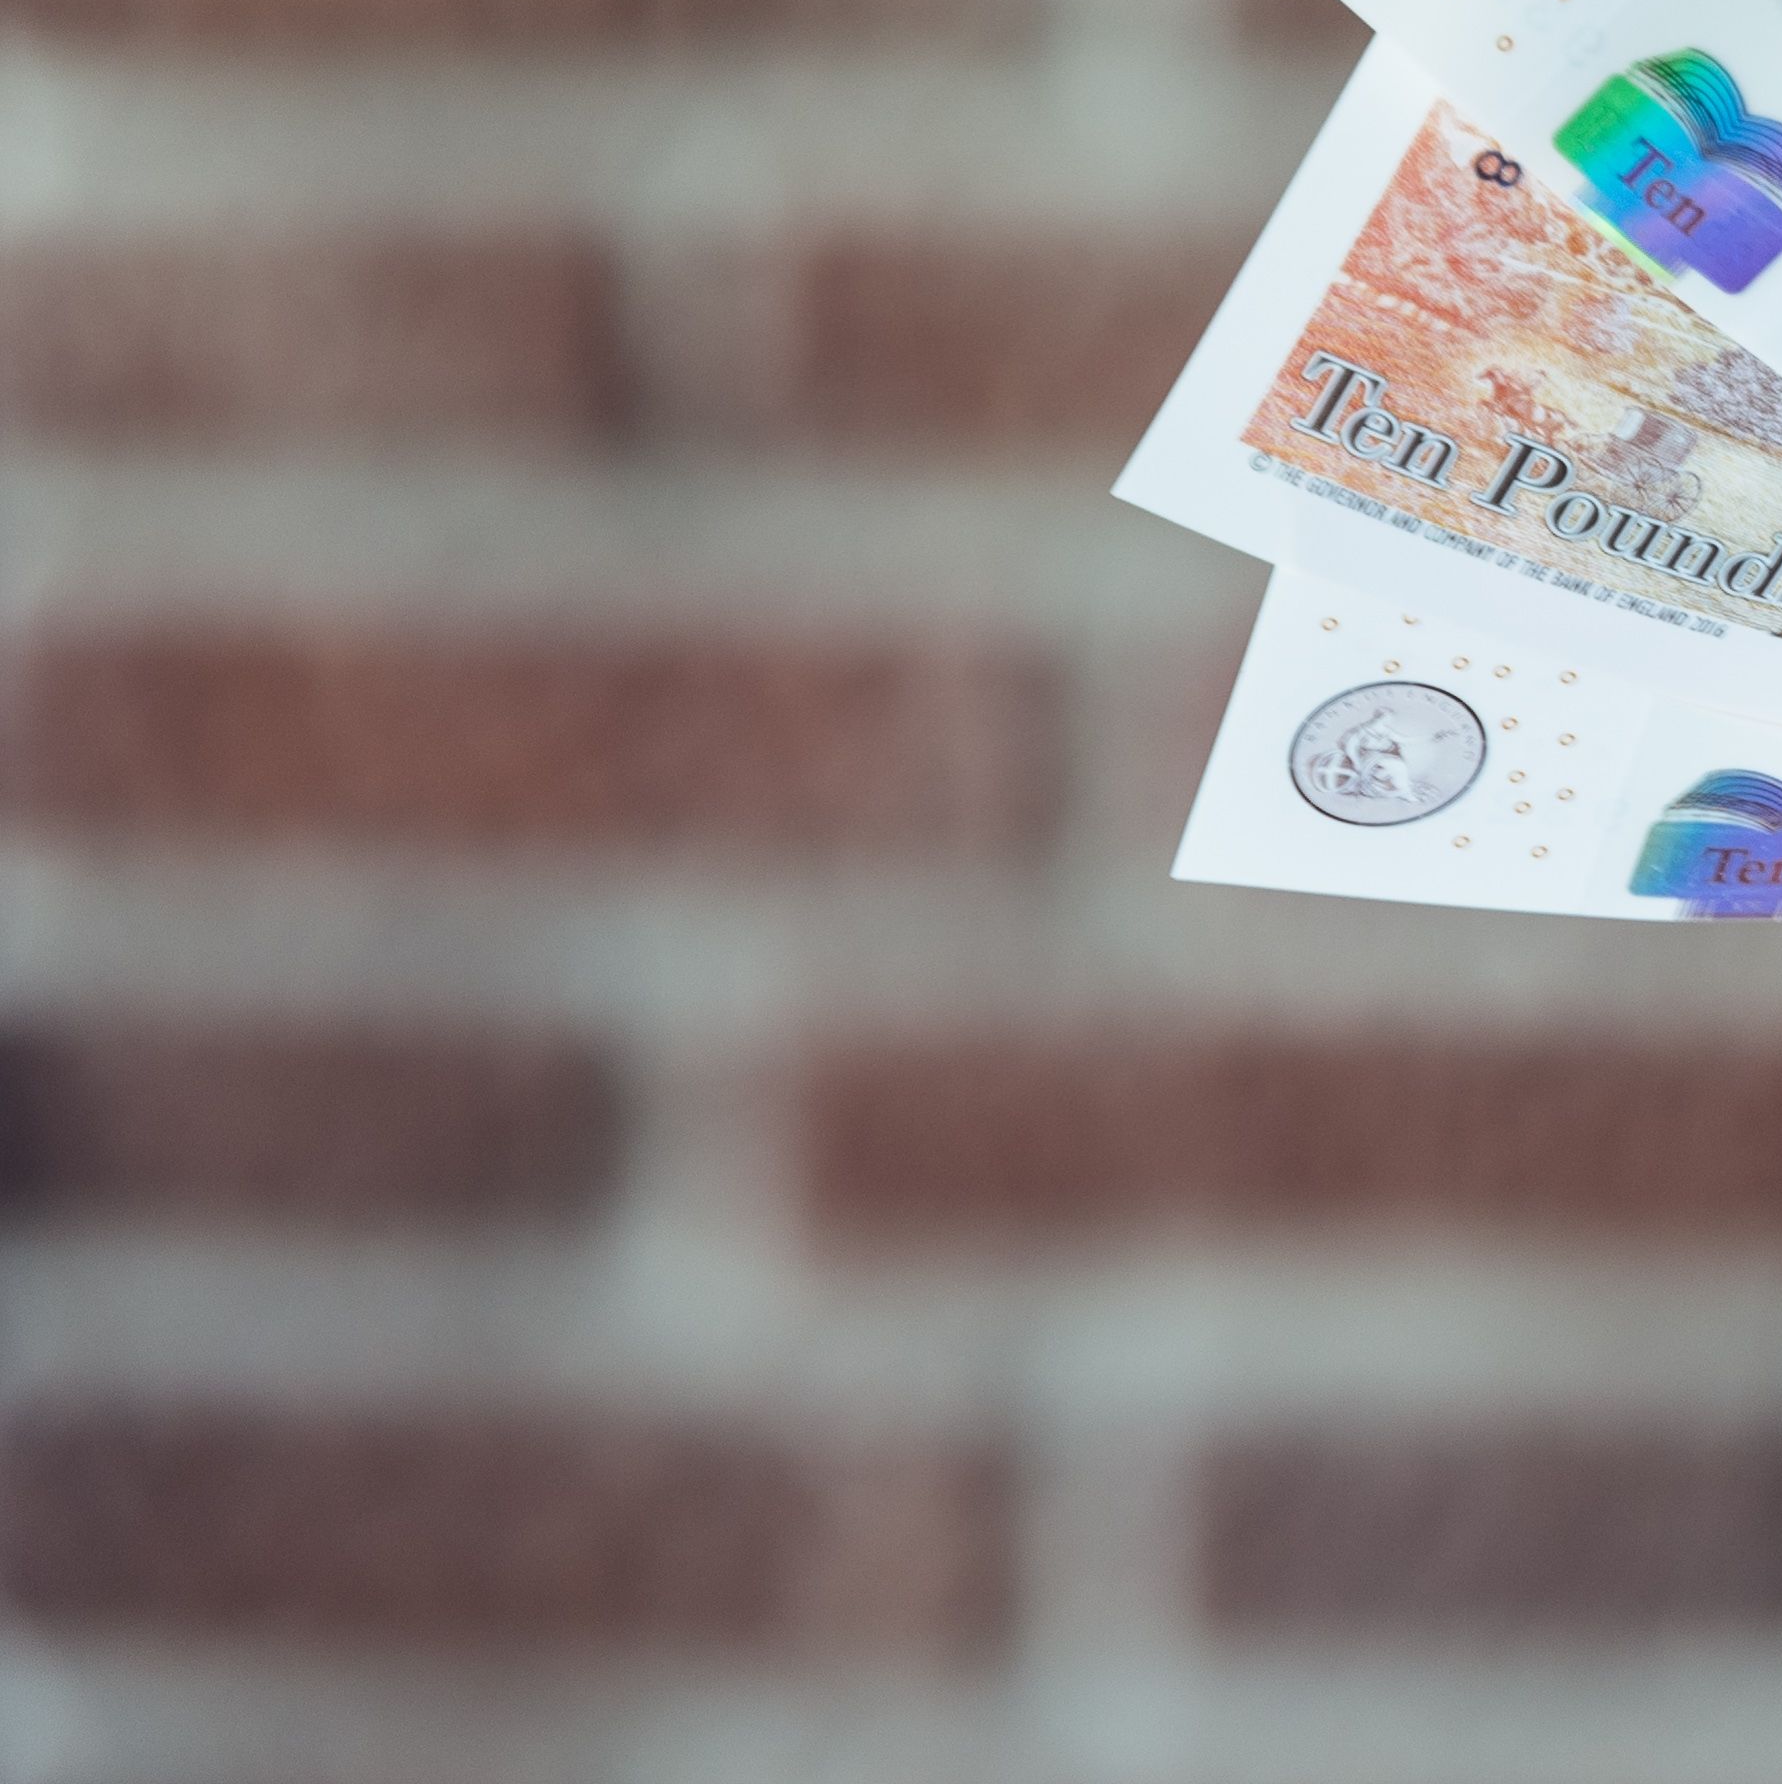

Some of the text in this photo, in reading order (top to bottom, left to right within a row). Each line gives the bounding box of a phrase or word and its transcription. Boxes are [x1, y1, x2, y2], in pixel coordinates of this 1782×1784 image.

[1616, 135, 1706, 238] Ten
[1290, 348, 1462, 490] Ten
[1302, 474, 1389, 522] GOVERNOR
[1388, 510, 1422, 535] AND
[1421, 521, 1497, 562] COMPANY
[1493, 549, 1518, 572] OF
[1517, 558, 1548, 582] THE
[1549, 568, 1592, 596] BANK
[1592, 583, 1617, 605] OF
[1616, 591, 1688, 627] ENGLAND
[1690, 614, 1728, 639] 2016
